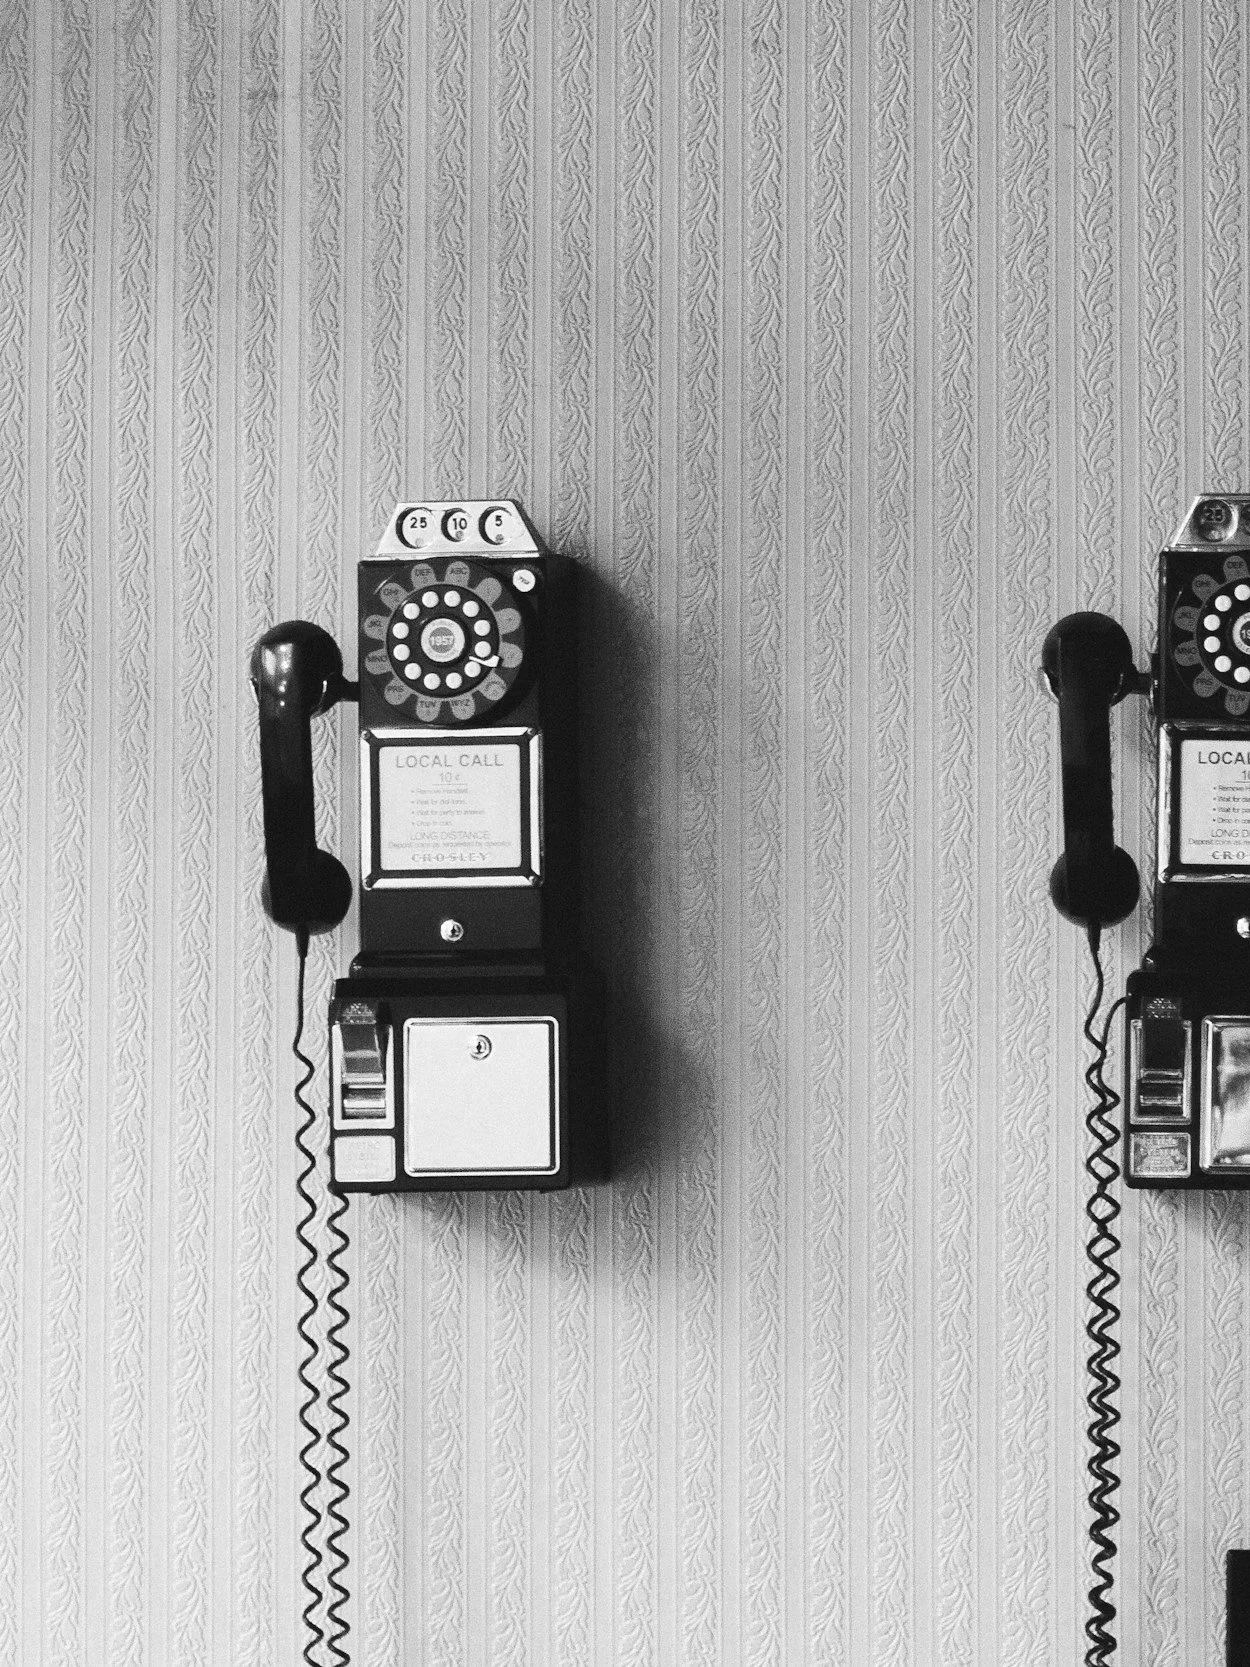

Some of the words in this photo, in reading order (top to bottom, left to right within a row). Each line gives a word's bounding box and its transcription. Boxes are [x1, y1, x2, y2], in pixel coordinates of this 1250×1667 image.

[410, 517, 428, 529] 25
[452, 518, 468, 531] 10
[495, 515, 503, 527] 5
[431, 636, 454, 646] 1957
[396, 755, 453, 768] LOCAL
[459, 754, 504, 767] CALL
[411, 831, 439, 841] LONG
[441, 831, 490, 840] DISTANCE
[1211, 829, 1239, 838] LONG
[411, 853, 488, 862] CROSLEY
